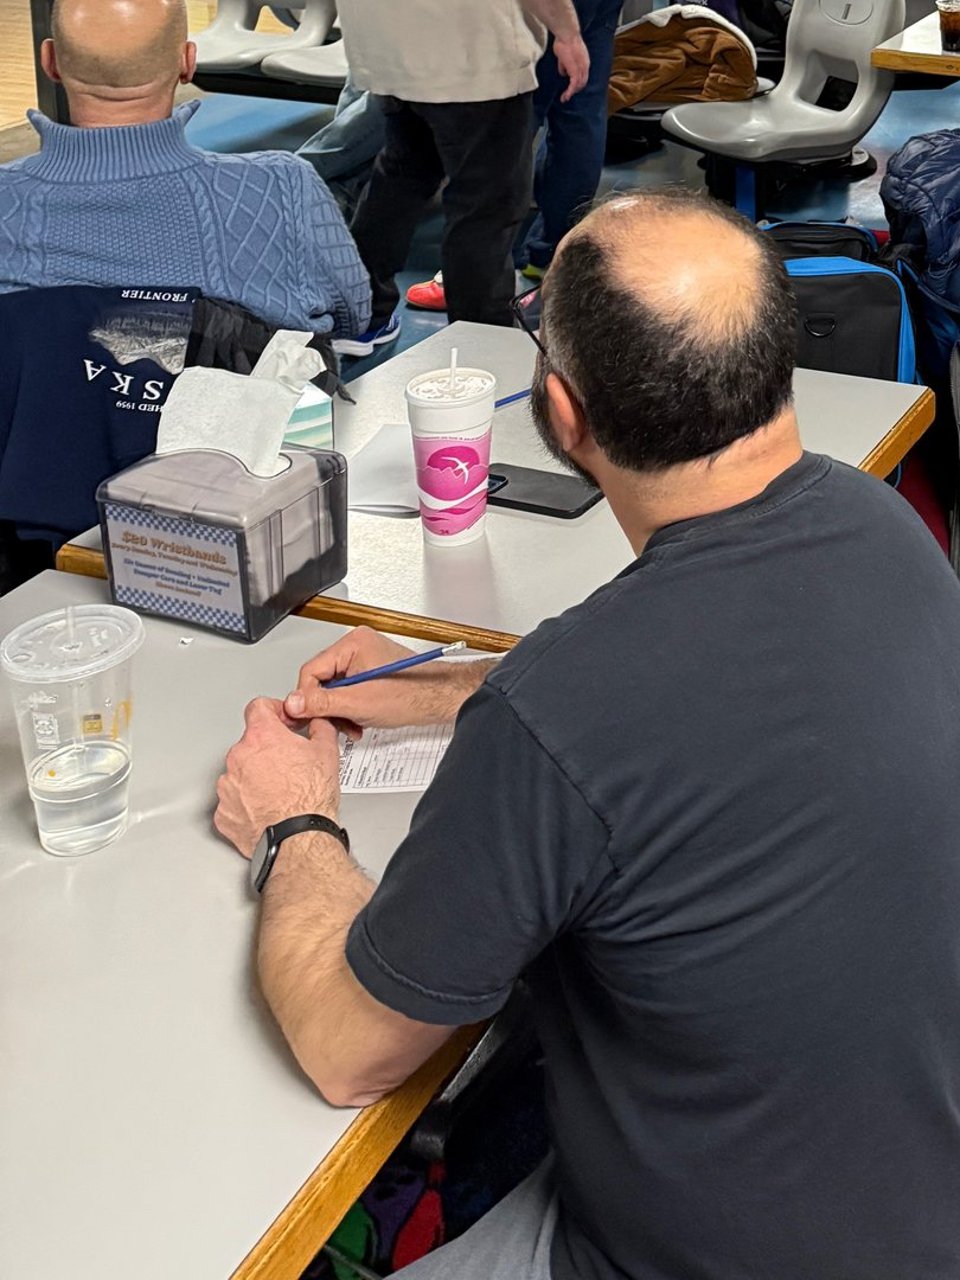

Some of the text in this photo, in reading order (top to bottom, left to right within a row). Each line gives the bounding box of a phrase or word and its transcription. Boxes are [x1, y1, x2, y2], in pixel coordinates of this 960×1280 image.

[121, 289, 189, 303] FRONTIER
[83, 359, 164, 400] SKA
[116, 400, 136, 410] 1959
[150, 538, 227, 564] Wristbands
